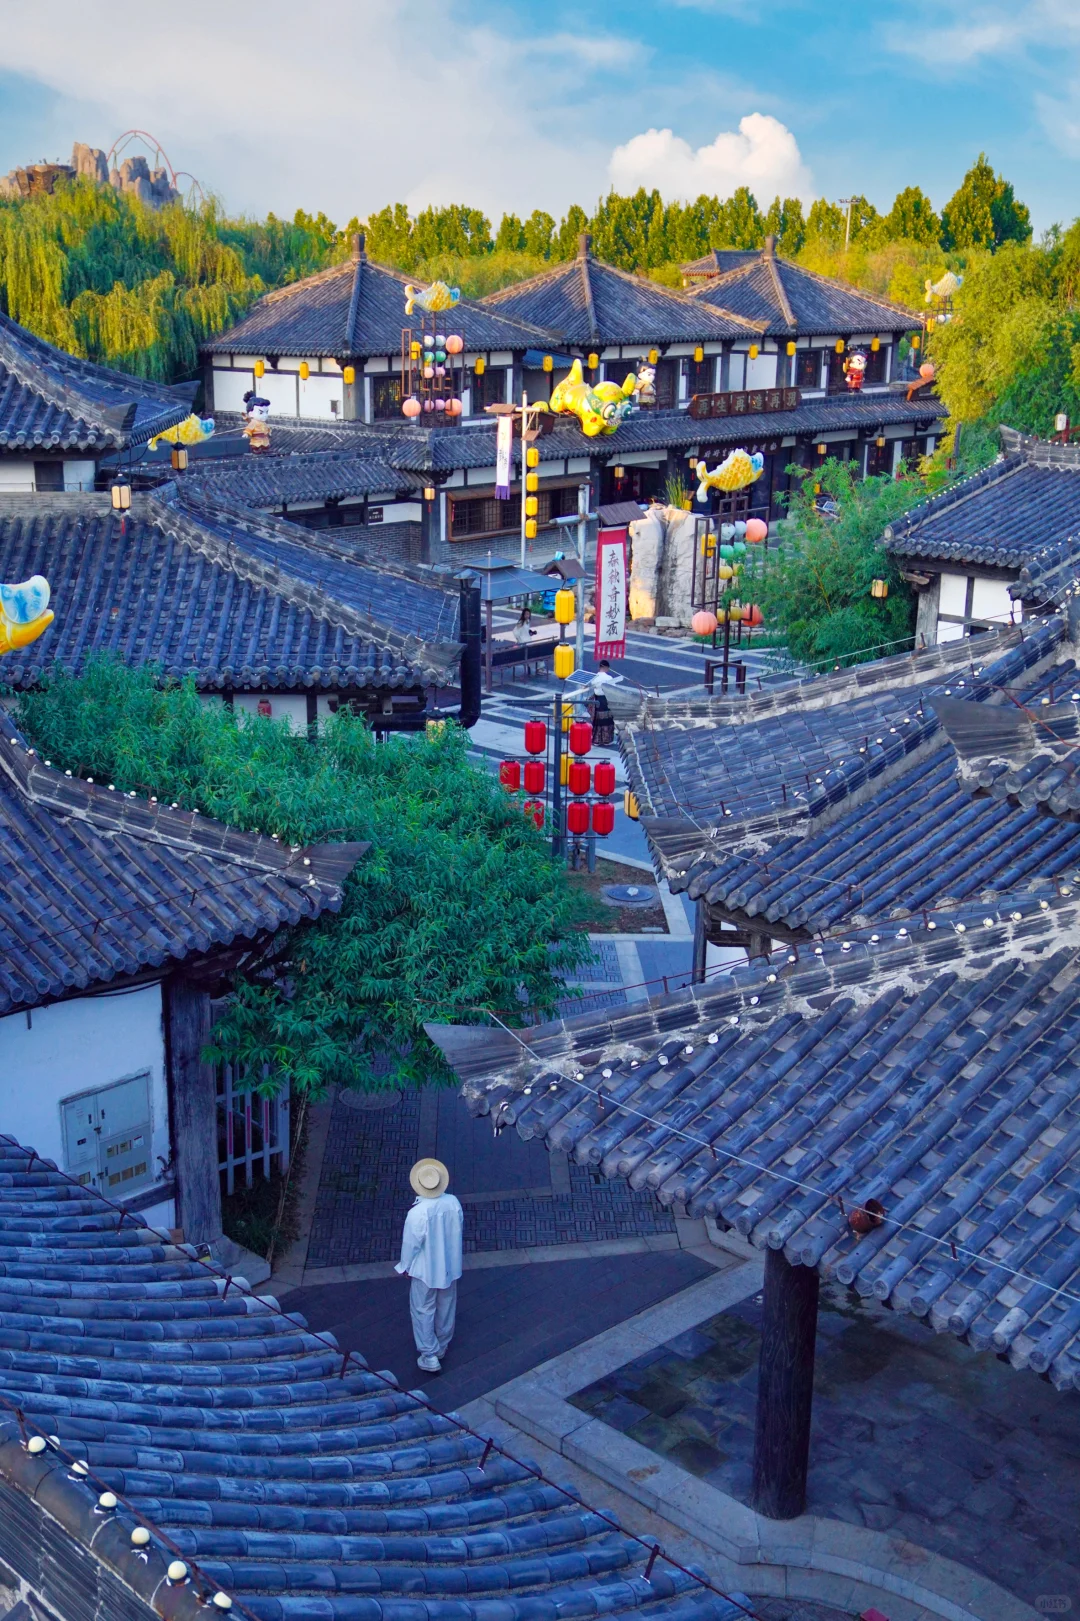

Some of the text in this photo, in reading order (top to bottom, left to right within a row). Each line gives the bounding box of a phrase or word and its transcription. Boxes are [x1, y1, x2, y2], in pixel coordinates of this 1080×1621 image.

[605, 549, 621, 636] 春秋奇妙夜
